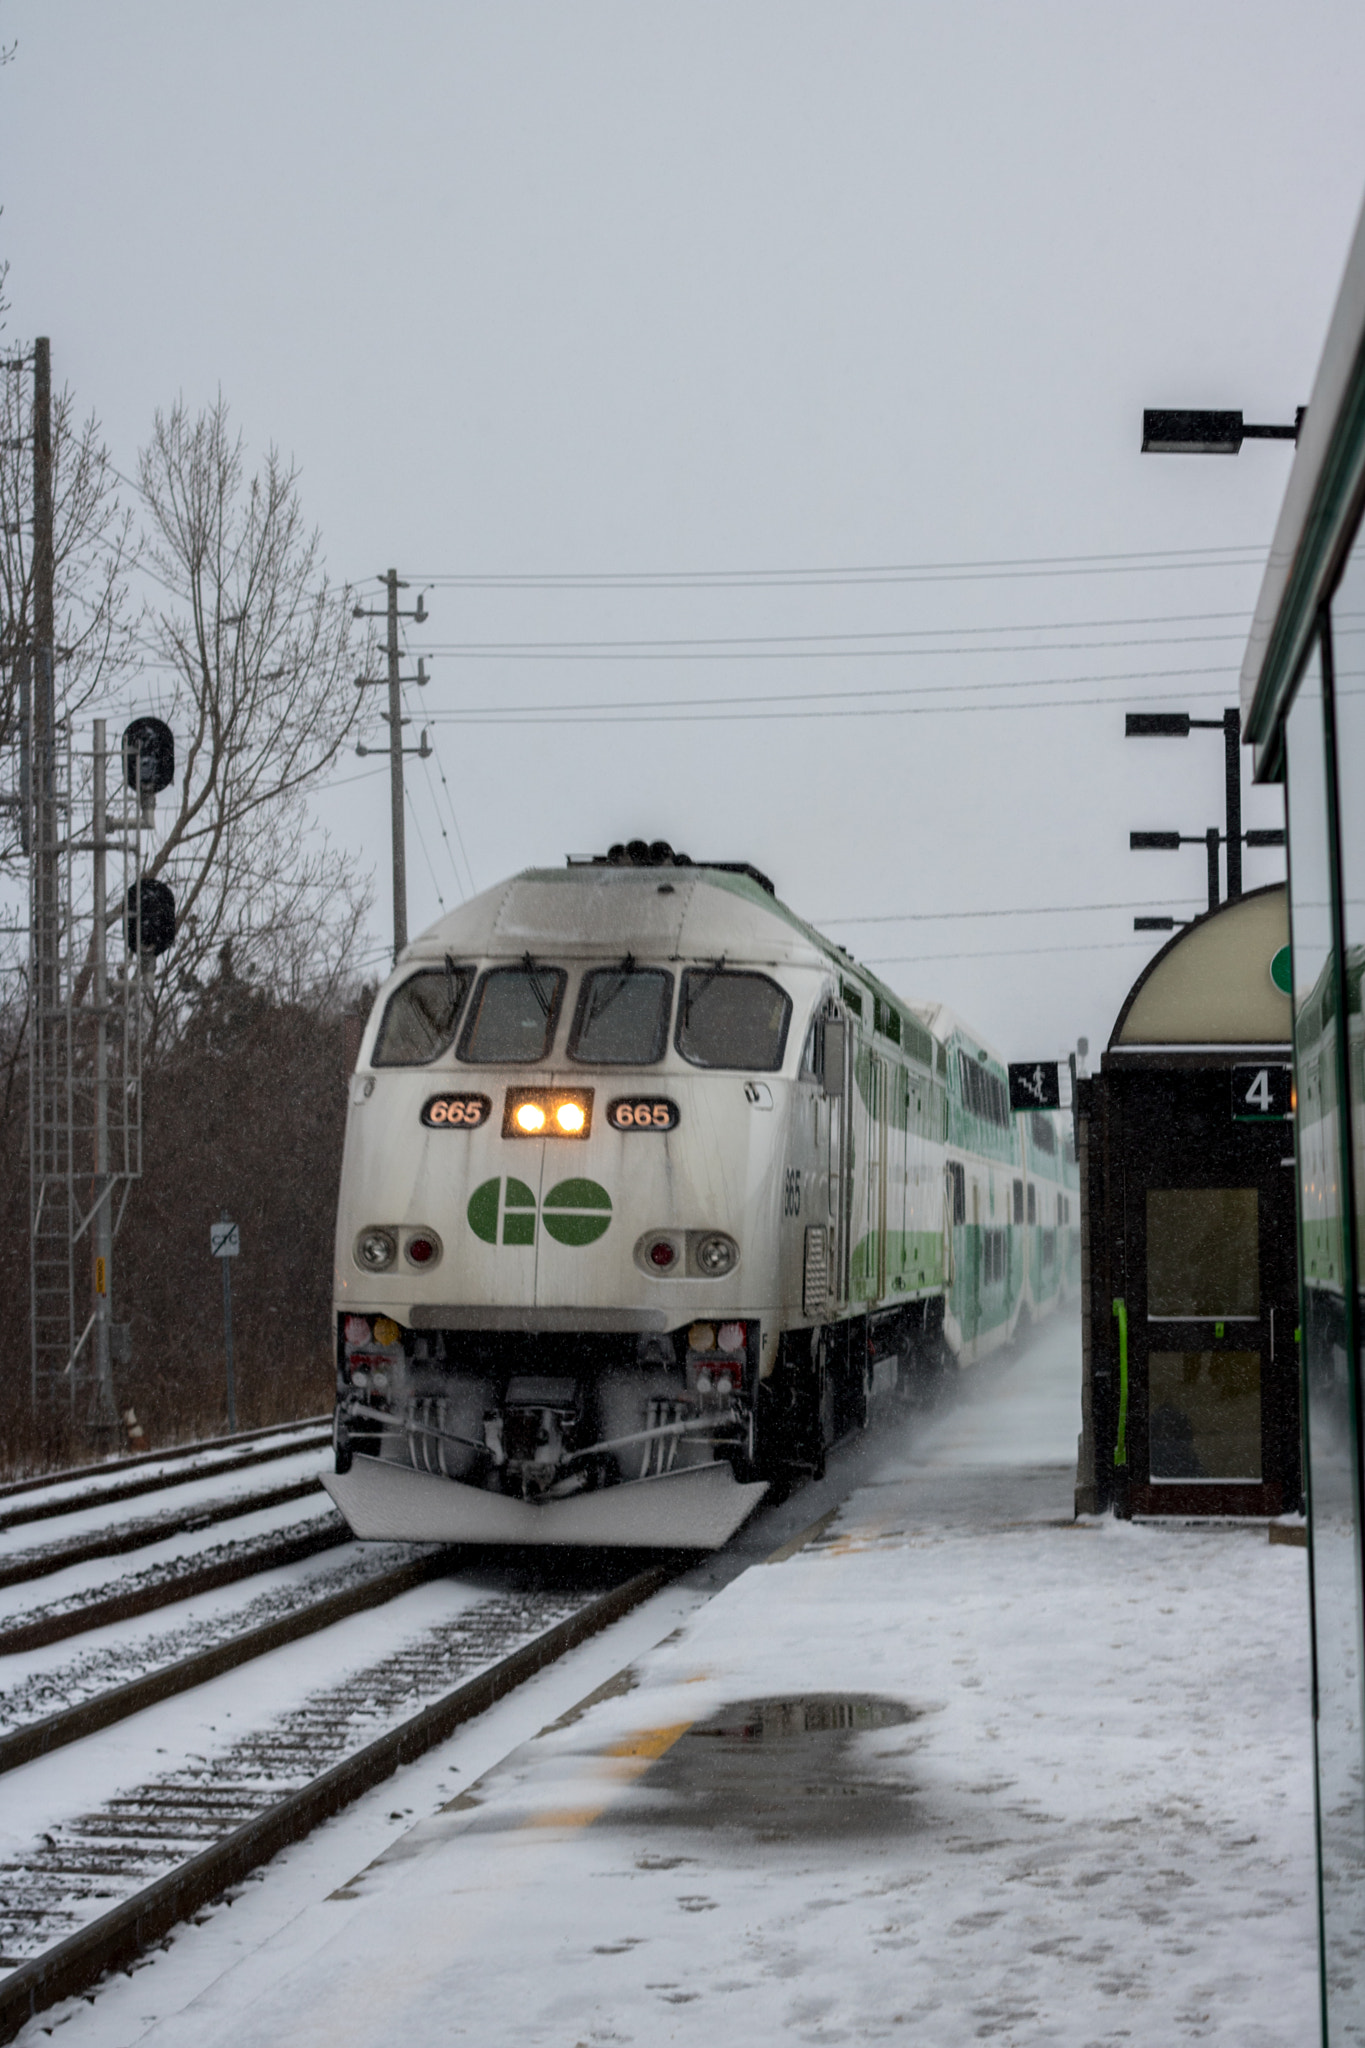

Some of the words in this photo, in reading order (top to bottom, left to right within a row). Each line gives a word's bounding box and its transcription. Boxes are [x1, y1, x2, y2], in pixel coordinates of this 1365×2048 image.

[1245, 1070, 1273, 1112] 4
[430, 1100, 483, 1123] 665
[616, 1104, 670, 1126] 665
[762, 1333, 768, 1351] F
